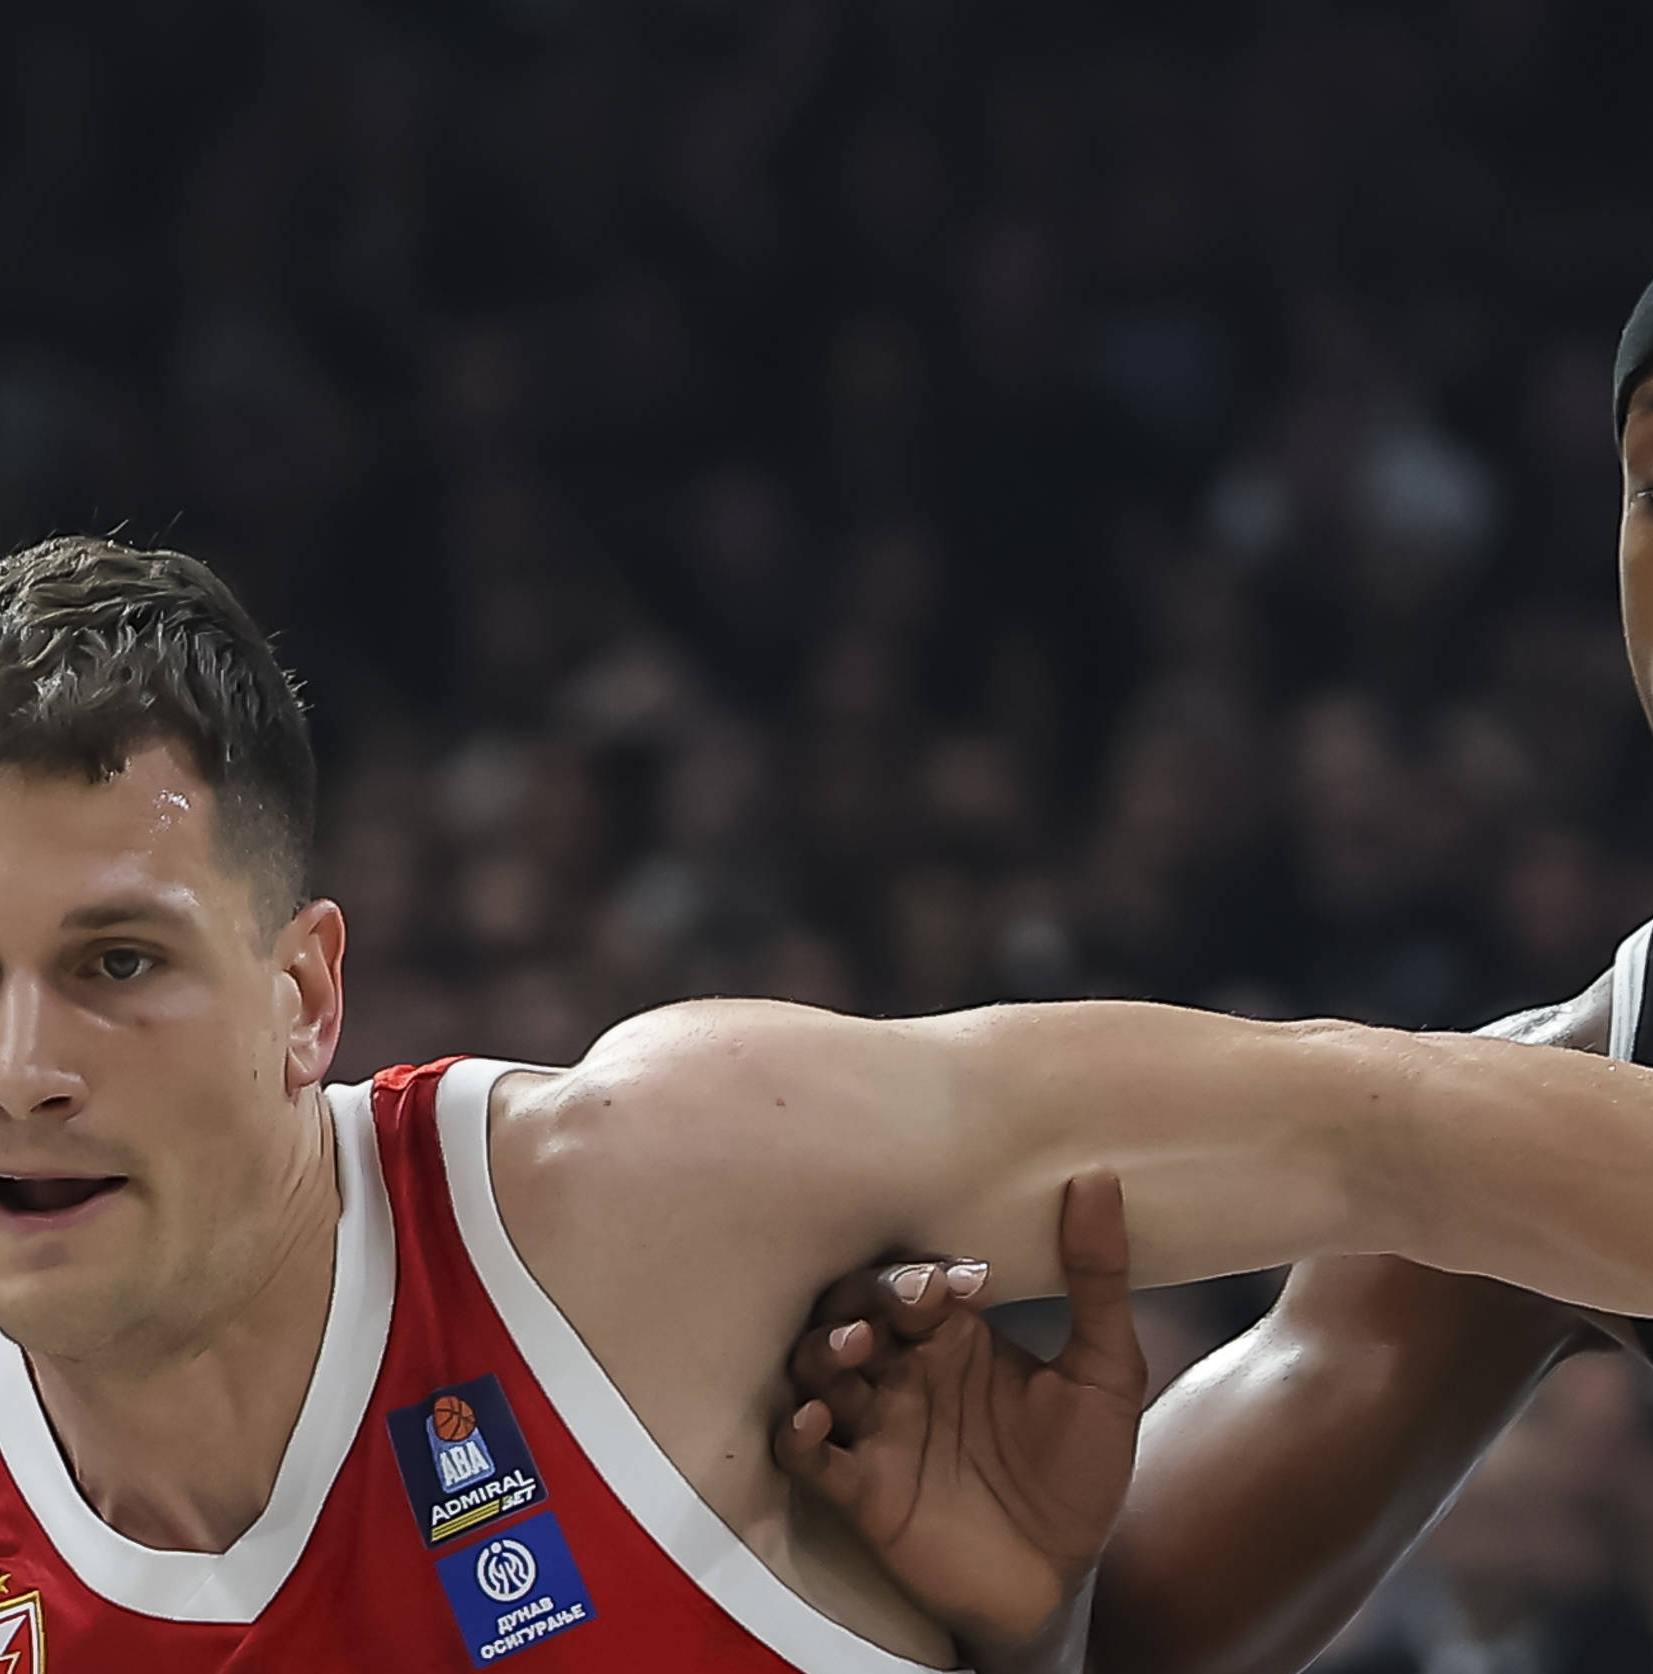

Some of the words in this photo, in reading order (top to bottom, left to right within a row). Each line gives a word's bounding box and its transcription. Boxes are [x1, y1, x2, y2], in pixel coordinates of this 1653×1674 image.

[438, 1440, 490, 1488] ABA
[431, 1469, 536, 1526] ADMIRAL
[480, 1603, 587, 1660] ОСИГУРАЊЕ
[497, 1596, 554, 1636] ДУНАВ
